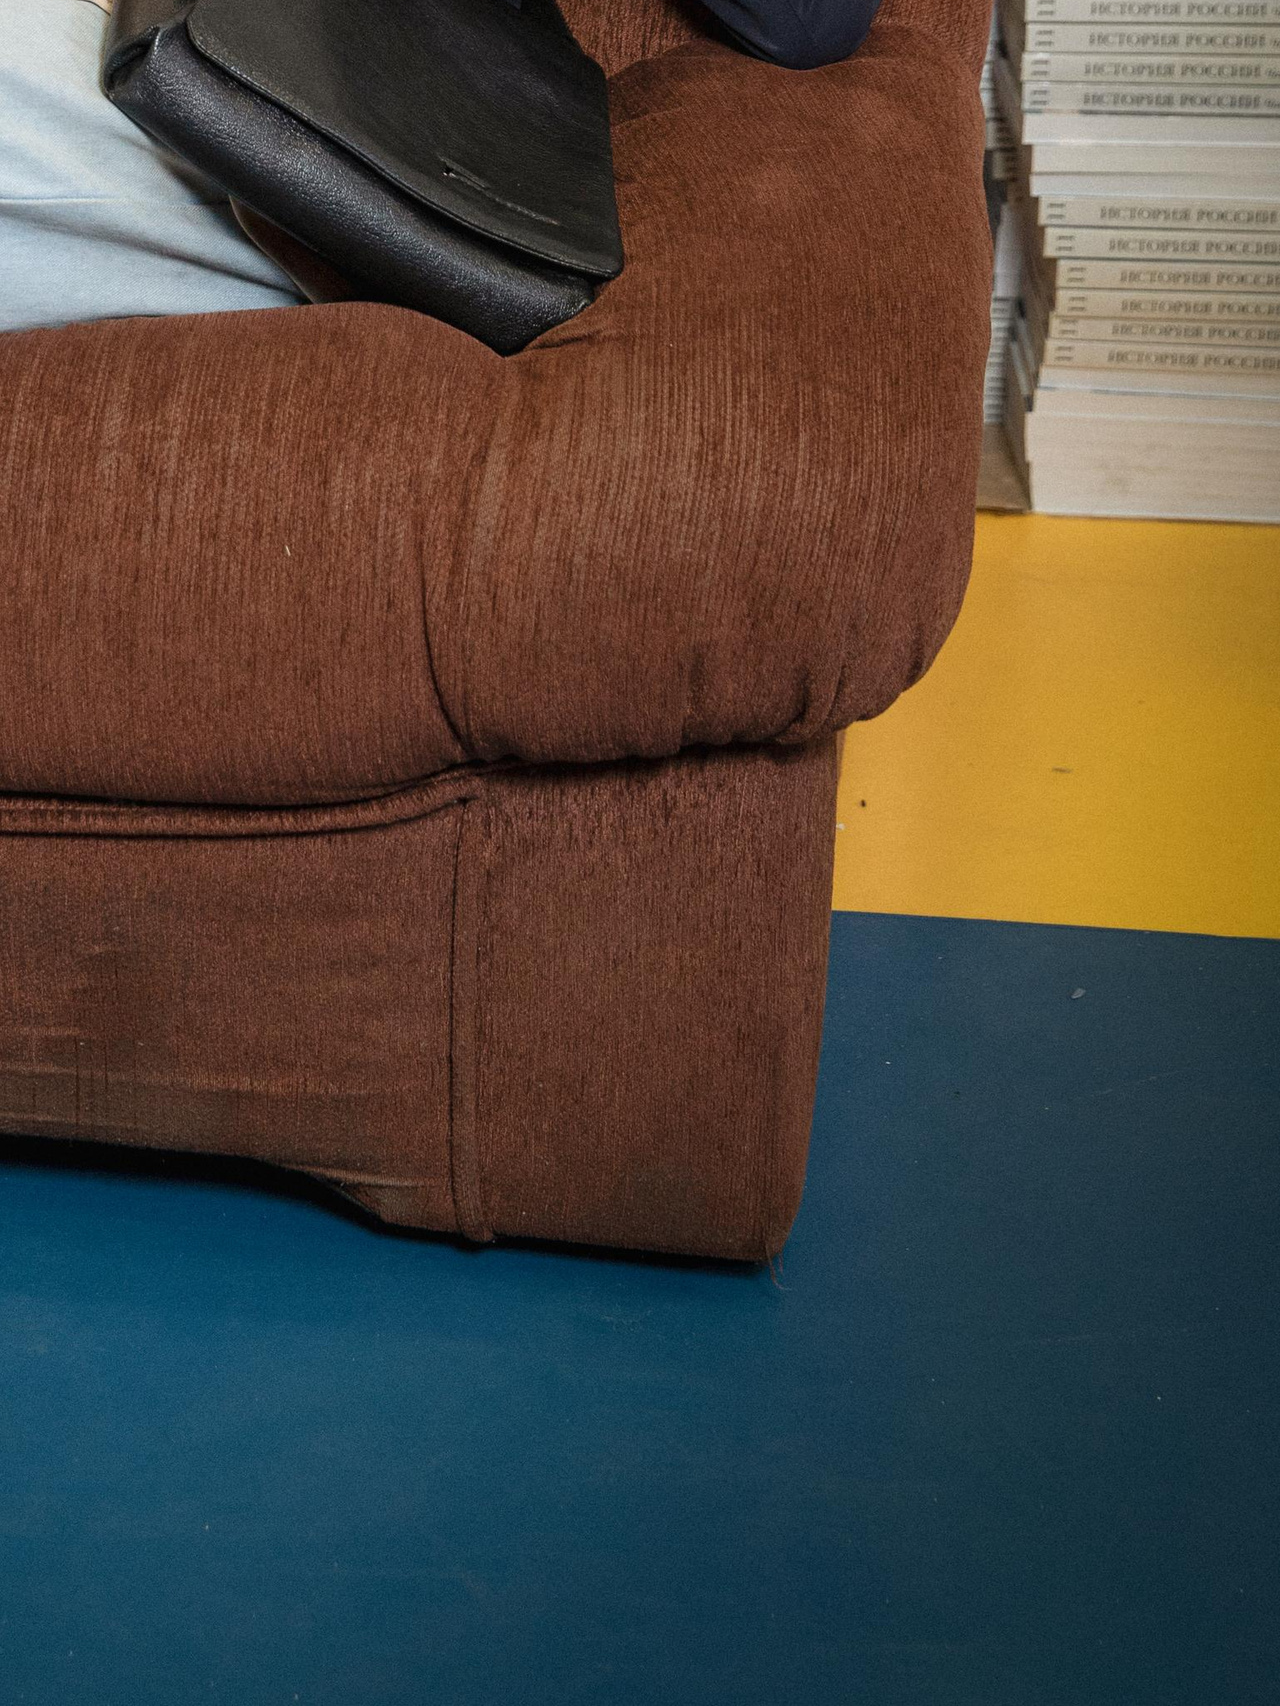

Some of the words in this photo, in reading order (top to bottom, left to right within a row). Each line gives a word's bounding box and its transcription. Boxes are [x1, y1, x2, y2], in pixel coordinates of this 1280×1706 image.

[1090, 0, 1181, 16] ИСТОРИЯ
[1187, 1, 1268, 17] РОССИИ
[1089, 31, 1180, 47] ИСТОРИЯ
[1185, 32, 1266, 48] РОССИИ
[1084, 62, 1175, 78] ИСТОРИЯ
[1180, 62, 1261, 79] РОССИИ
[1083, 91, 1174, 108] ИСТОРИЯ
[1179, 92, 1261, 109] РОССИИ
[1100, 206, 1191, 221] ИСТОРИЯ
[1196, 207, 1278, 224] РОССИИ
[1108, 238, 1199, 254] ИСТОРИЯ
[1119, 269, 1210, 285] ИСТОРИЯ
[1121, 299, 1212, 314] ИСТОРИЯ
[1112, 323, 1203, 338] ИСТОРИЯ
[1107, 349, 1199, 366] ИСТОРИЯ
